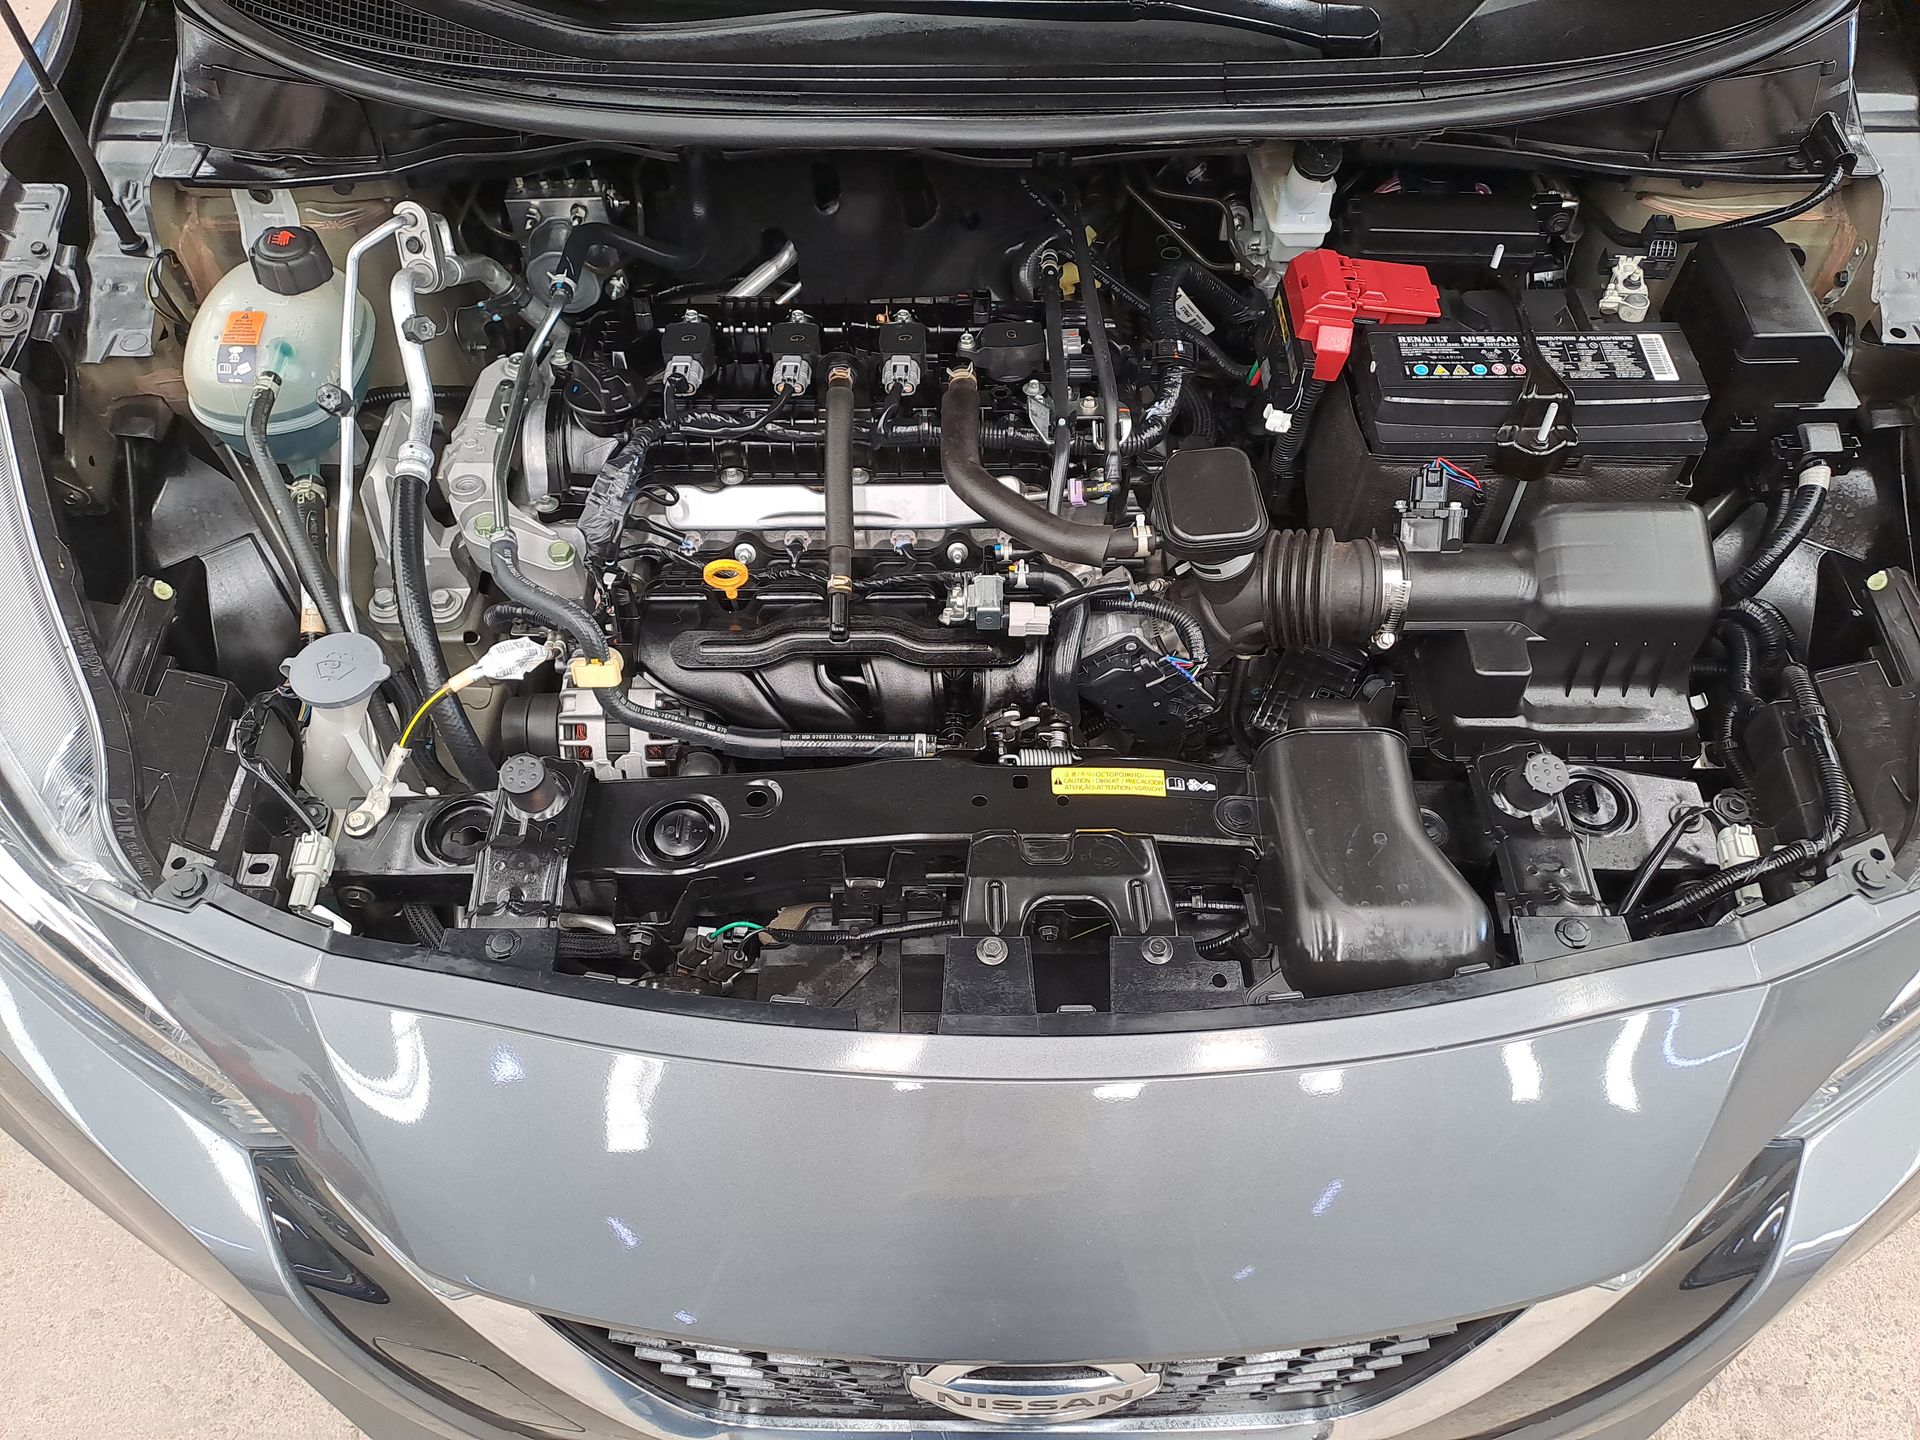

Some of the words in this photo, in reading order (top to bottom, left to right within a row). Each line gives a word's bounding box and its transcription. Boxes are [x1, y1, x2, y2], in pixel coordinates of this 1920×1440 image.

[1398, 335, 1449, 343] RENAULT
[1460, 335, 1518, 343] NISSAN
[937, 1389, 1133, 1410] NISSAN
